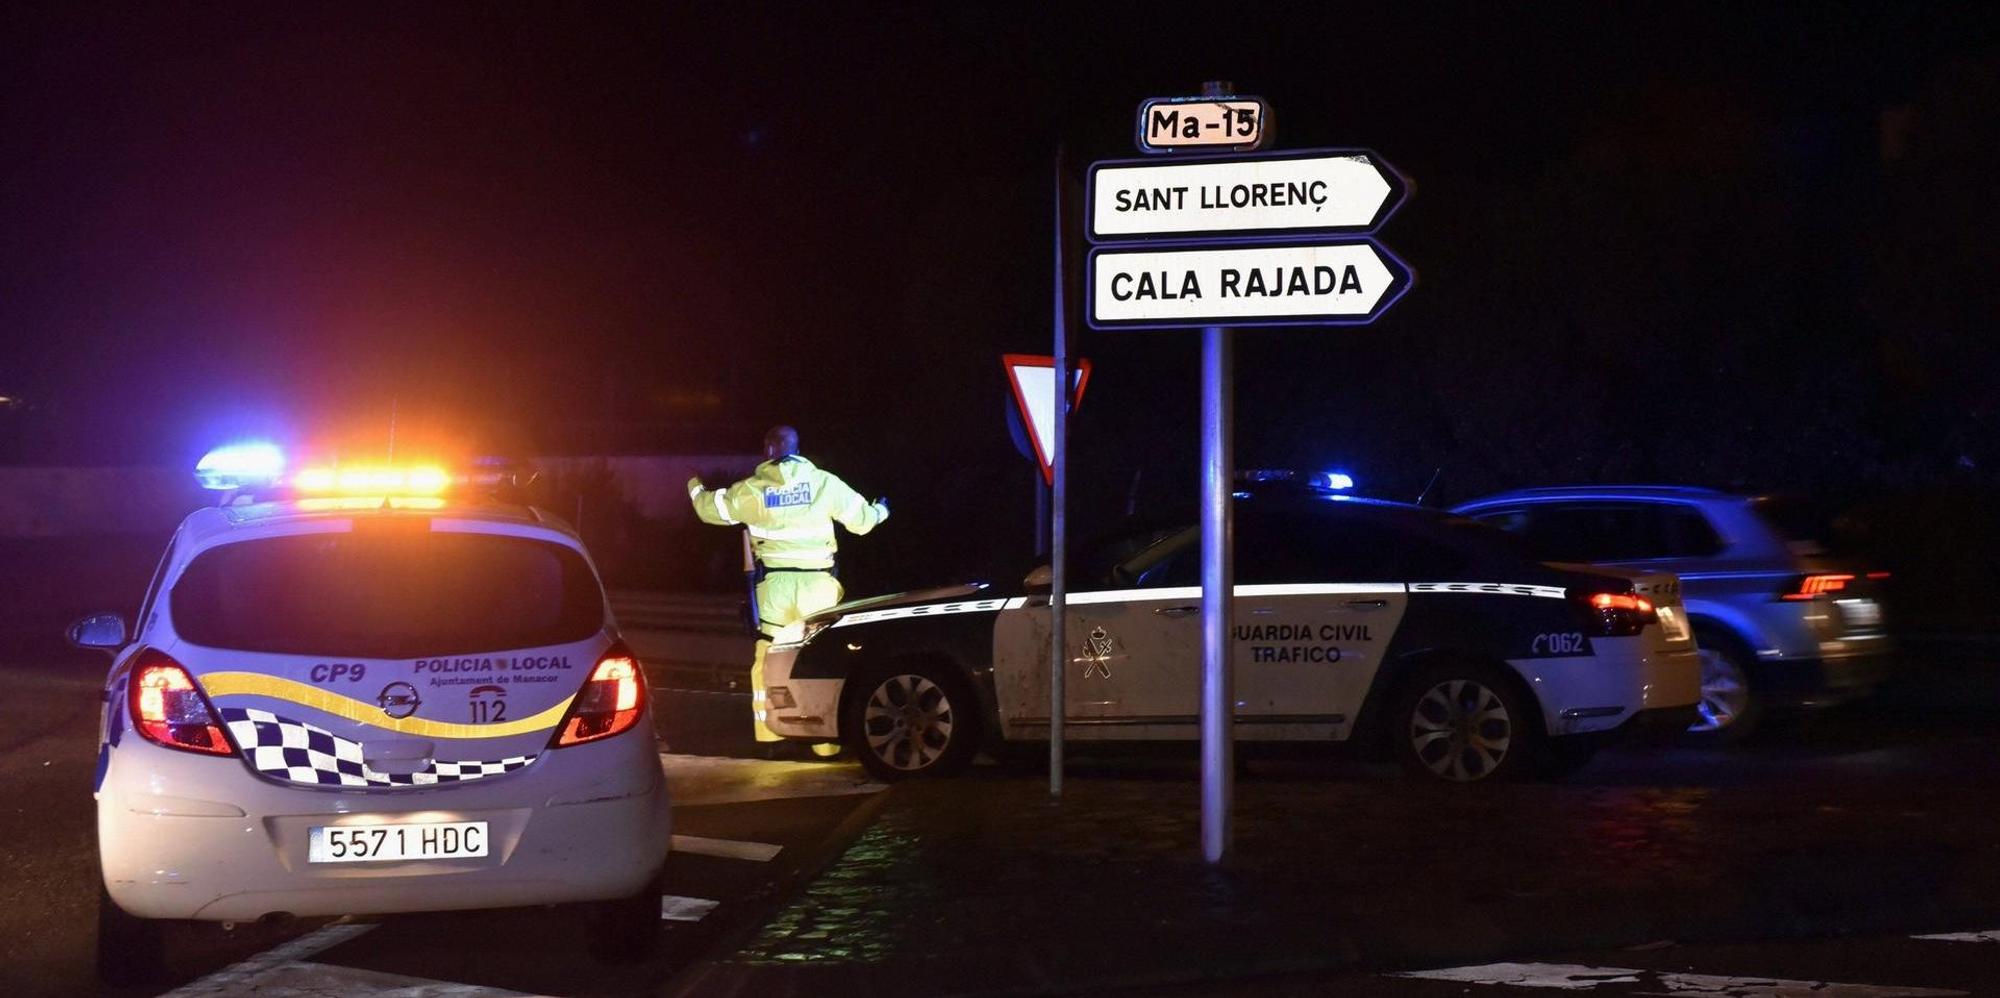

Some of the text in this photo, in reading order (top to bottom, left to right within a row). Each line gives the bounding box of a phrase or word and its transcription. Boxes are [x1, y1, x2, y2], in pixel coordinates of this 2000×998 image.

[1151, 110, 1255, 138] Ma-15
[1115, 181, 1328, 213] SANT LLORENÇ
[1111, 265, 1363, 301] CALA RAJADA
[779, 492, 811, 505] LOCAL
[1319, 625, 1373, 641] CIVIL
[1549, 632, 1583, 653] 062
[414, 656, 572, 673] POLICIA LOCAL
[1251, 646, 1341, 663] TRAFICO
[310, 663, 367, 683] CP9
[430, 674, 558, 686] Ajuntament de Manacor
[469, 700, 506, 724] 112
[329, 827, 481, 858] 5571 HDC
